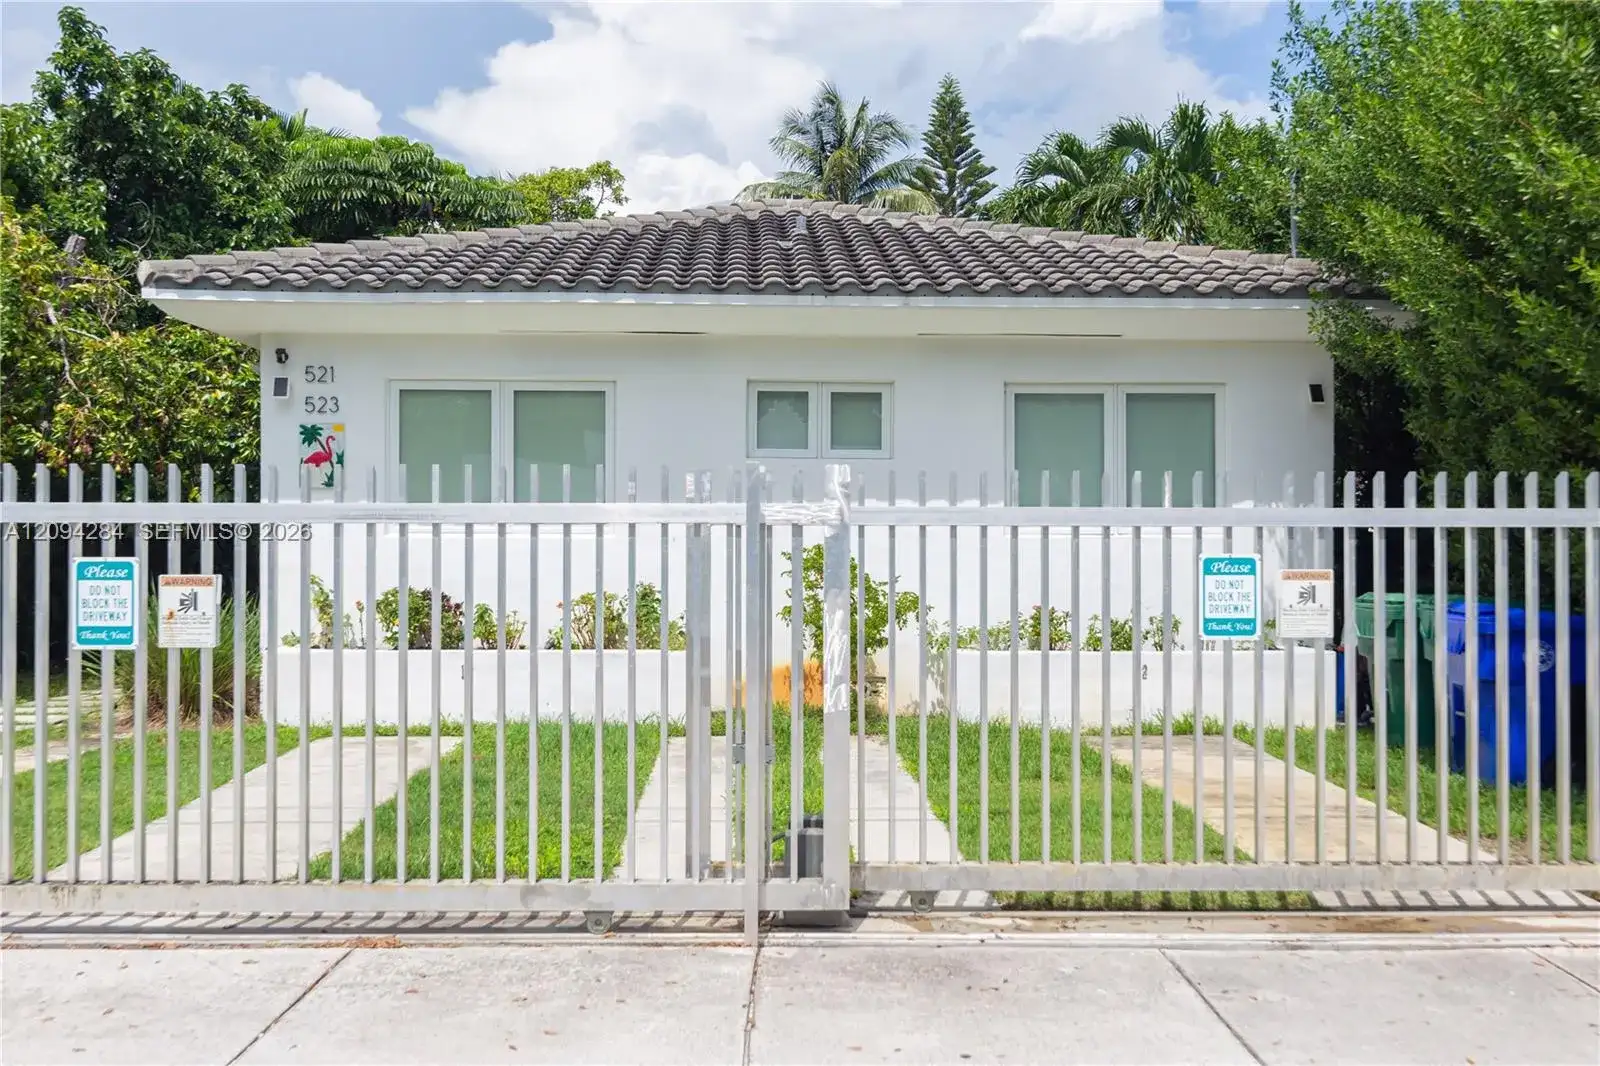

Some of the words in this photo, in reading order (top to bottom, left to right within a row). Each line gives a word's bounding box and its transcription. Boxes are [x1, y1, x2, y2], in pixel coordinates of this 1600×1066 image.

[304, 365, 335, 383] 521
[304, 396, 340, 414] 523
[83, 564, 129, 578] Please
[1210, 561, 1252, 573] Please
[89, 585, 101, 596] DO
[104, 585, 121, 596] NOT
[1215, 580, 1226, 590] DO
[1229, 580, 1244, 590] NOT
[1208, 592, 1234, 602] BLOCK
[1237, 592, 1251, 602] THE
[81, 598, 109, 609] BLOCK
[113, 598, 128, 609] THE
[1209, 604, 1250, 614] DRIVEWAY
[82, 611, 127, 622] DRIVEWAY
[1207, 622, 1234, 632] Thank
[1234, 622, 1254, 631] You!
[80, 630, 109, 641] Thank
[109, 630, 131, 640] You!
[1142, 664, 1148, 680] 2
